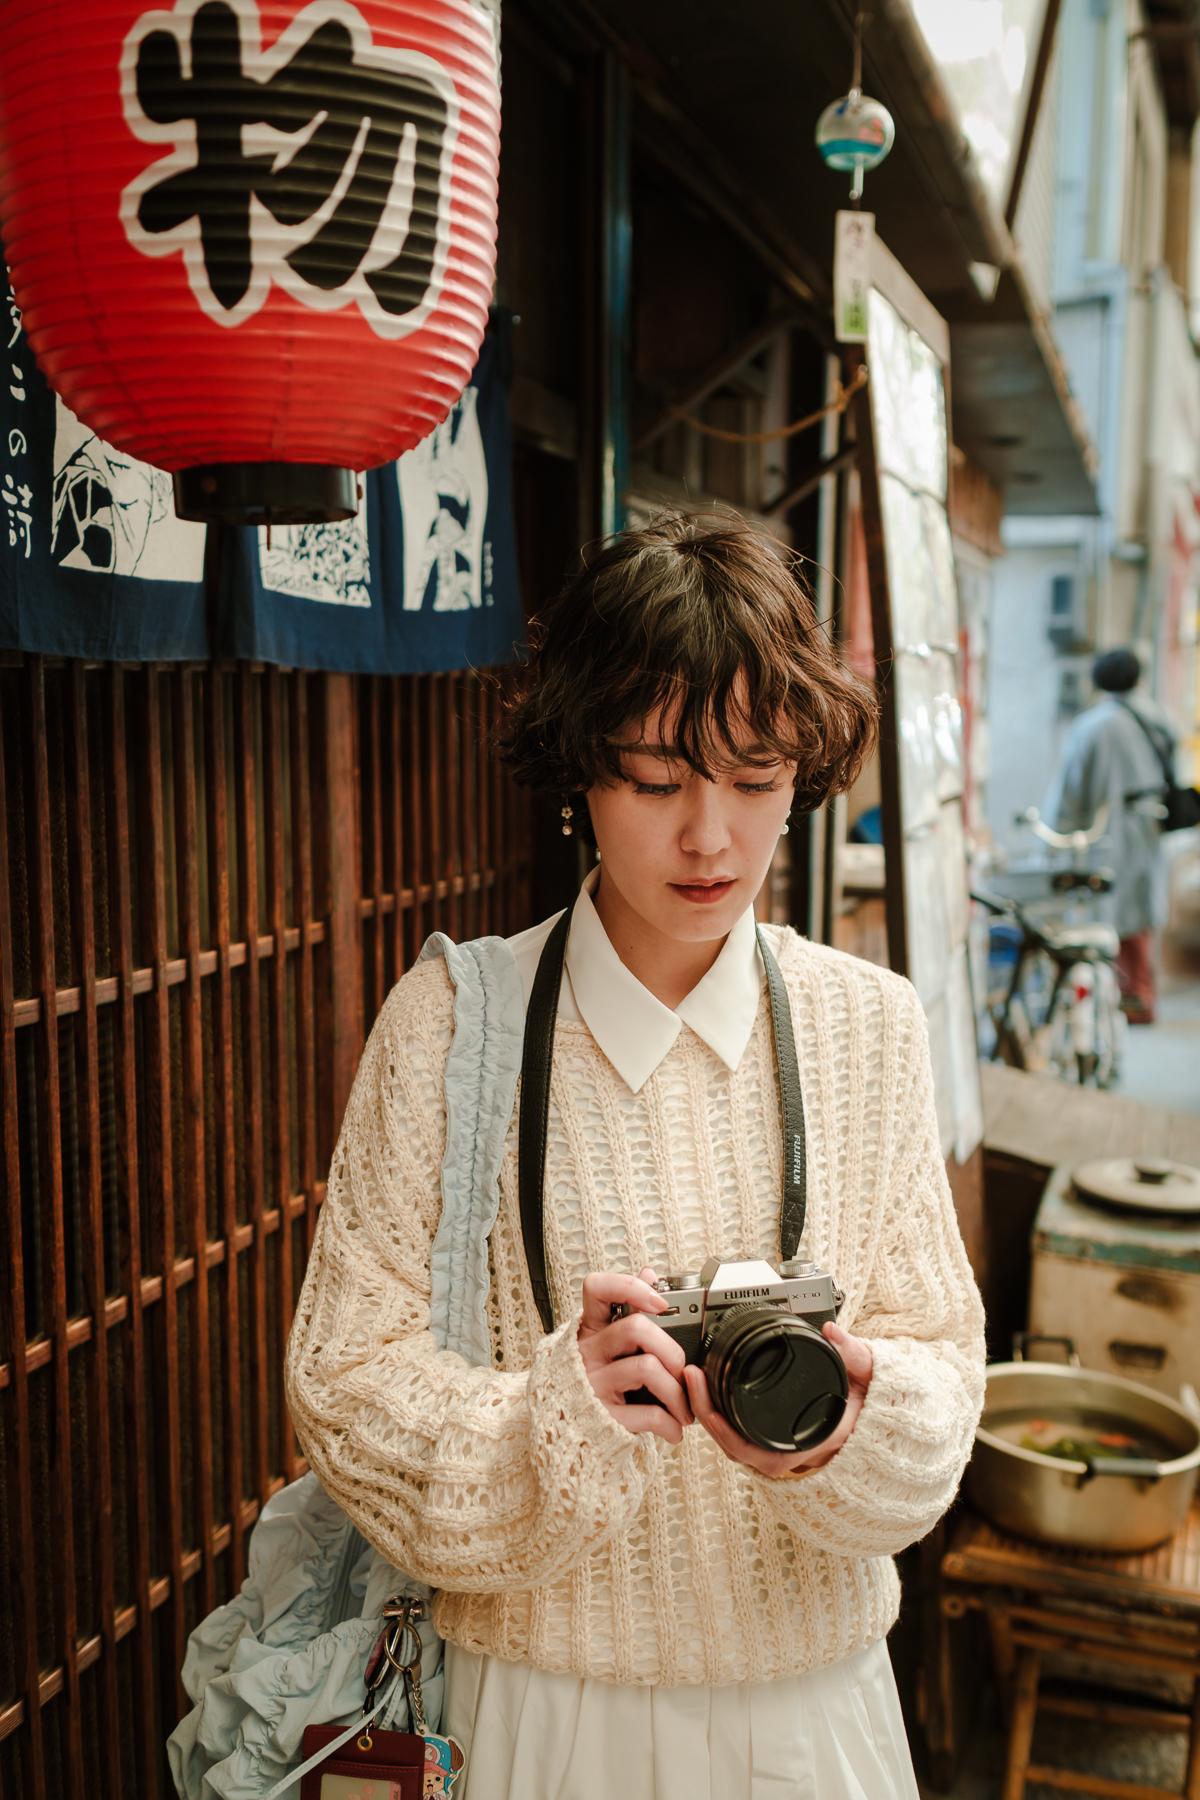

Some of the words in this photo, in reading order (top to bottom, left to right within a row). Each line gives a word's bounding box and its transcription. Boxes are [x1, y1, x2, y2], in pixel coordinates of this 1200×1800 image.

[126, 0, 454, 328] 物
[793, 1134, 801, 1185] FUJIFILM
[724, 1287, 770, 1300] FUJIFILM
